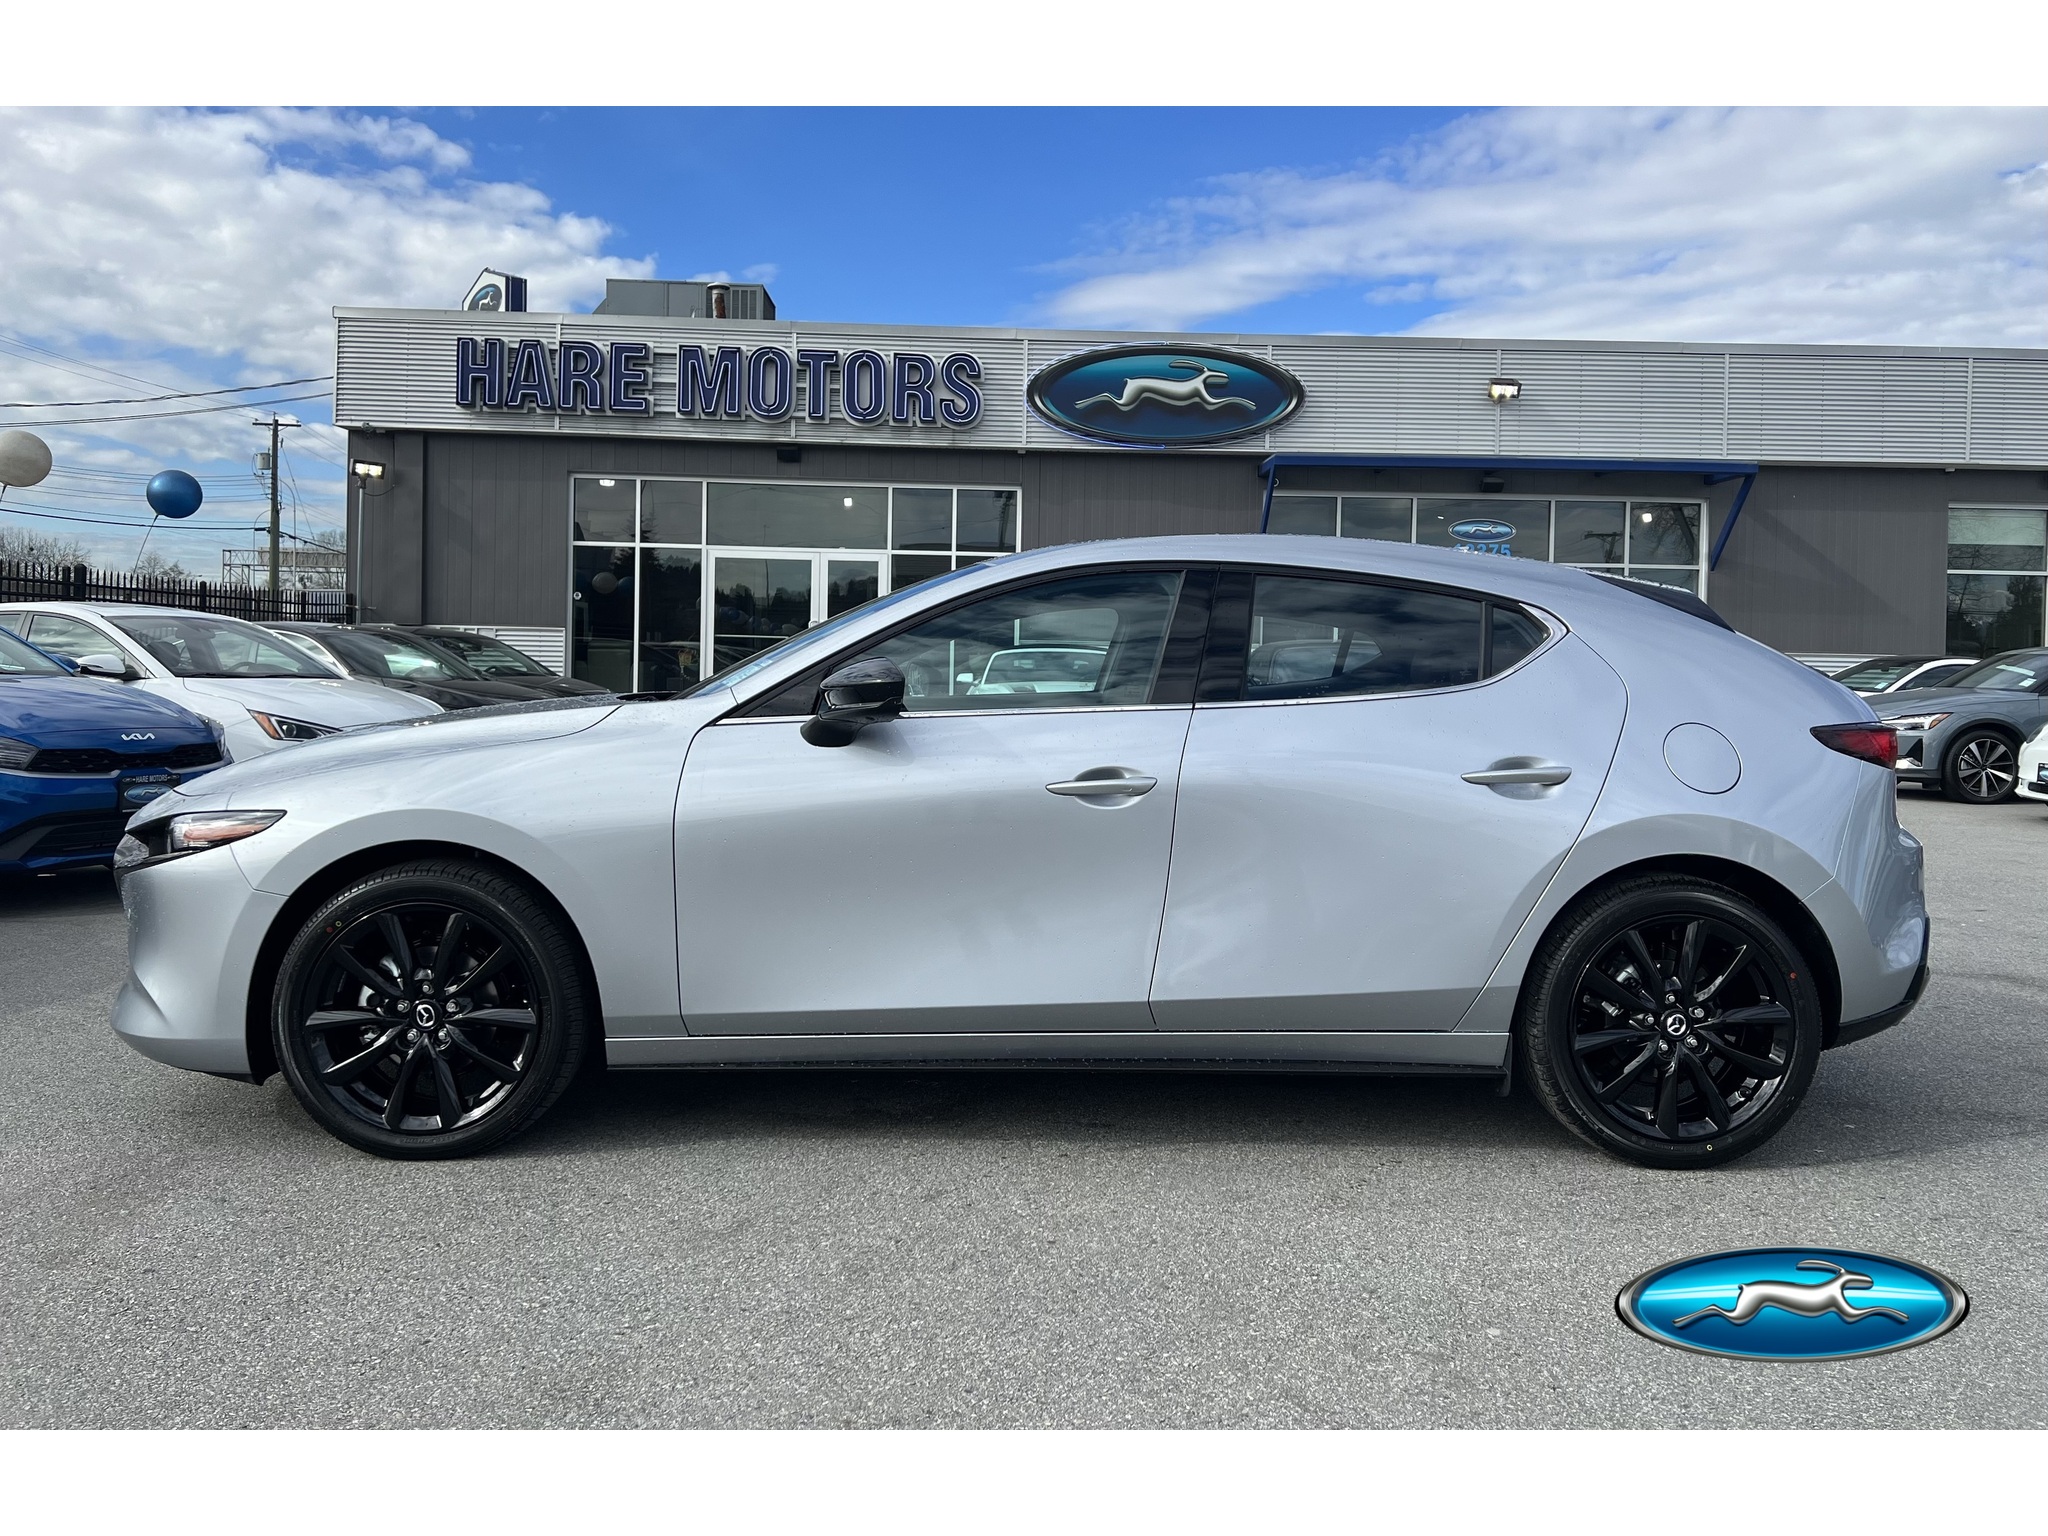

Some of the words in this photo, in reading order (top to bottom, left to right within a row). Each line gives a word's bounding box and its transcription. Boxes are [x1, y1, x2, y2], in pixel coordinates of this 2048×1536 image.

[456, 336, 652, 415] HARE
[677, 344, 983, 426] MOTORS
[121, 732, 155, 740] KIA
[135, 775, 149, 783] HARE
[149, 774, 168, 782] MOTORS
